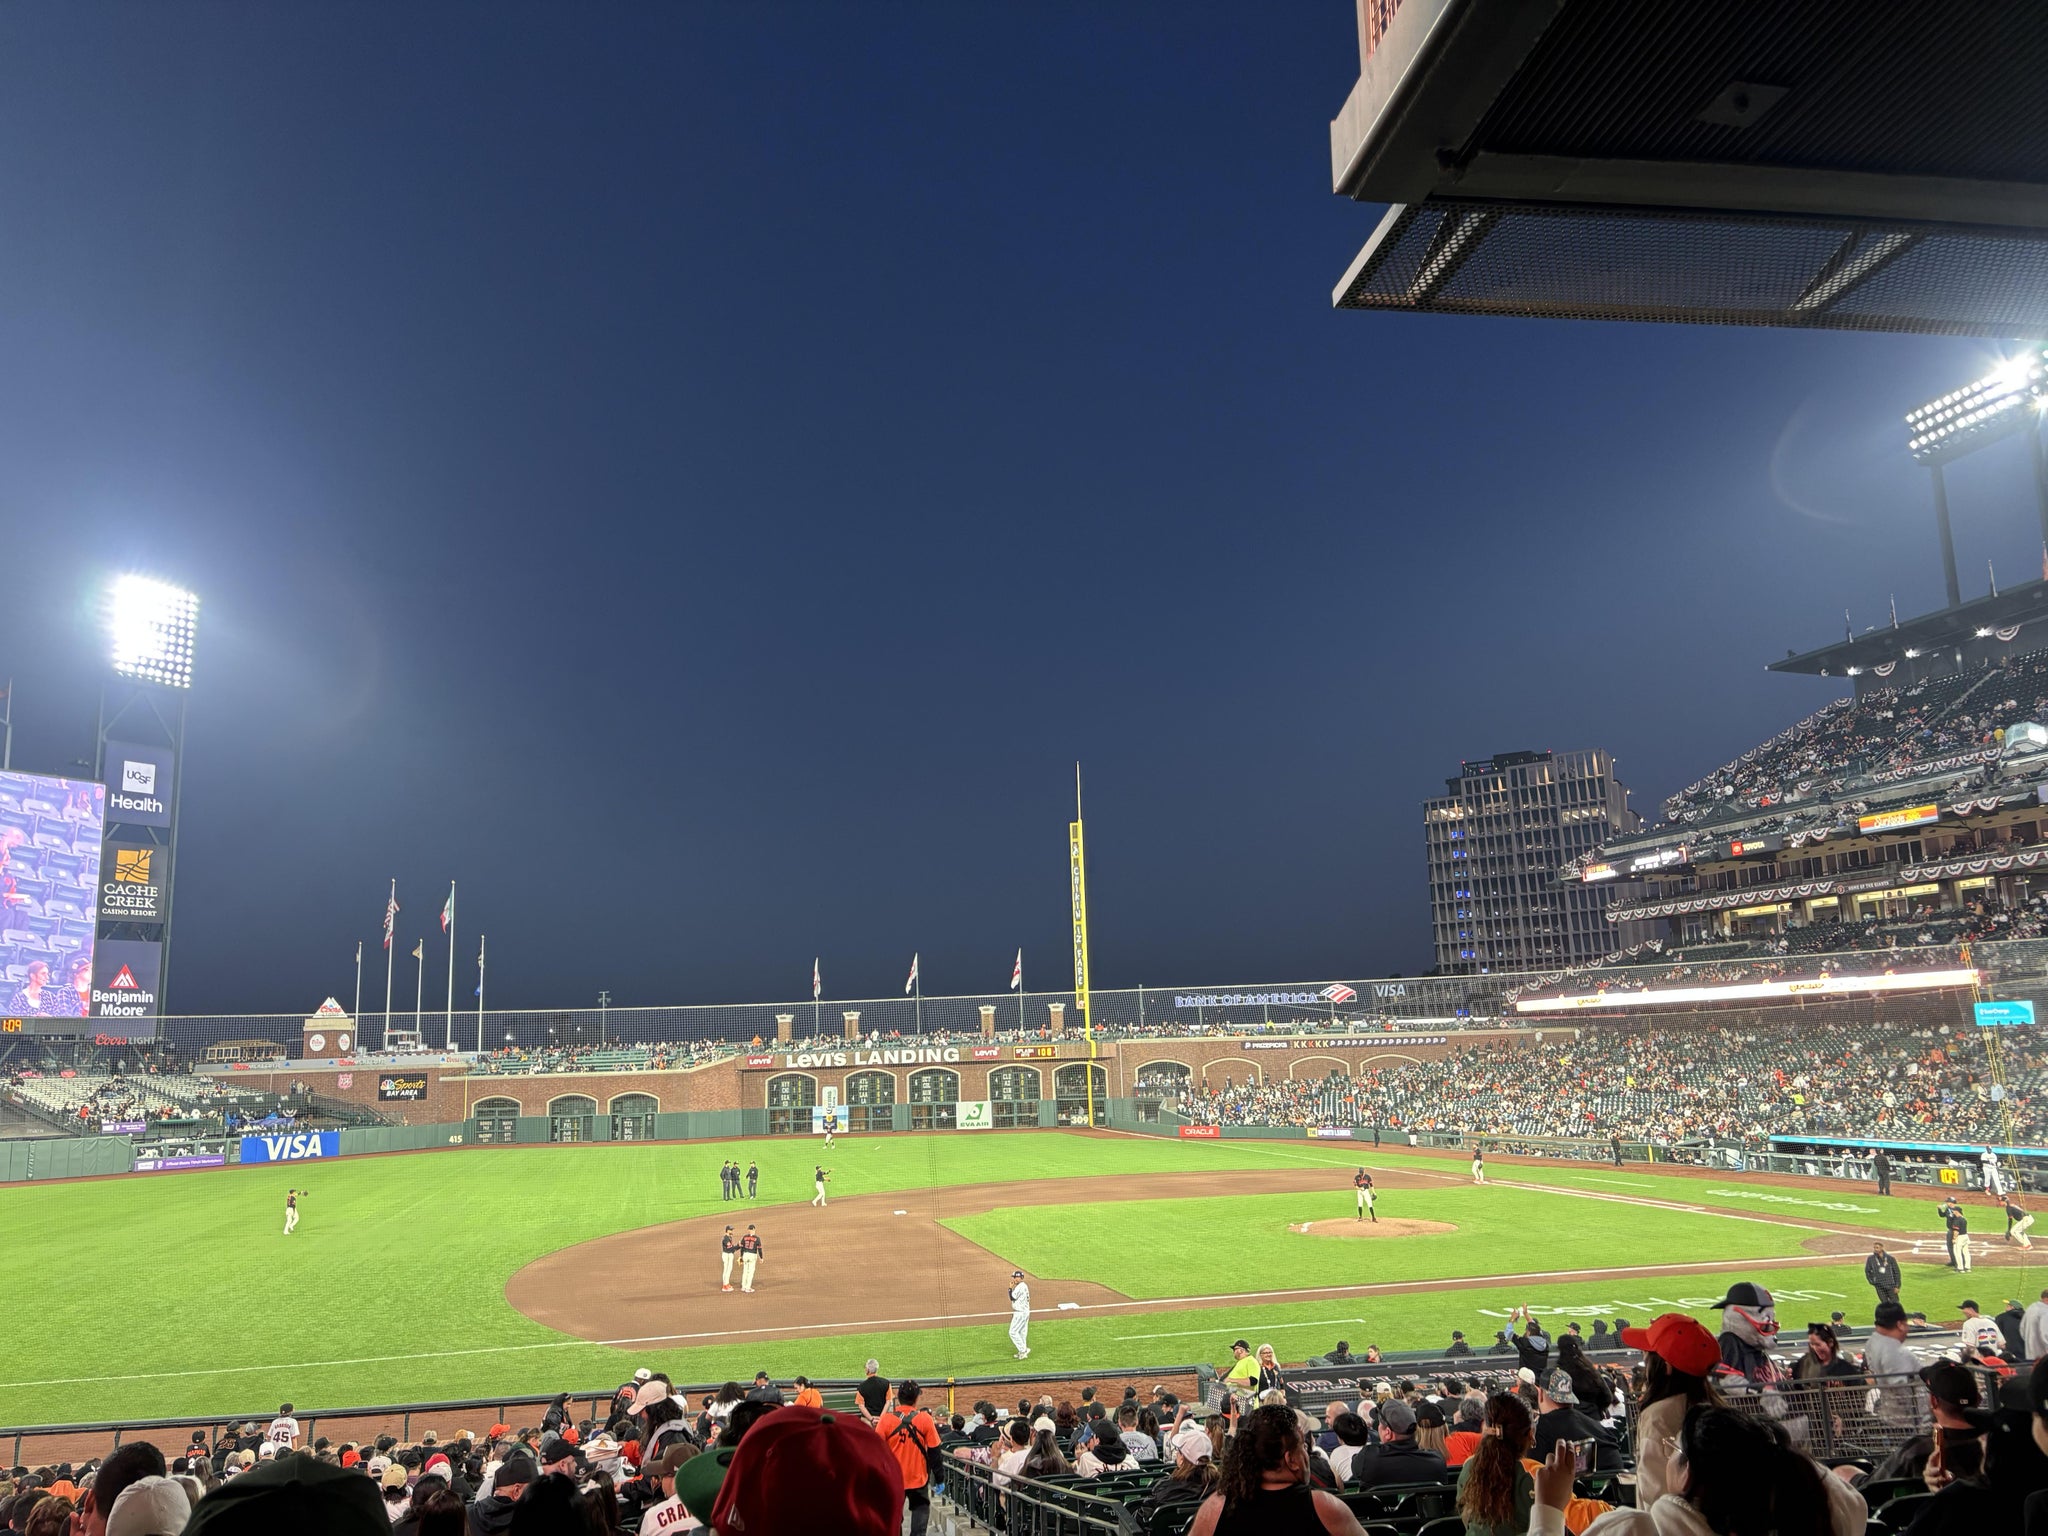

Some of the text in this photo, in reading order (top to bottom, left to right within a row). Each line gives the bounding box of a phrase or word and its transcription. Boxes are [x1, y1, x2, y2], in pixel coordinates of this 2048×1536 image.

[127, 770, 151, 784] UCSF
[111, 793, 162, 813] Health
[1742, 840, 1765, 851] TOYOTA
[103, 883, 158, 897] CACHE
[104, 895, 156, 909] CREEK
[101, 908, 157, 917] CASINO RESORT
[1375, 983, 1406, 997] VISA
[92, 990, 153, 1005] Benjamin
[1174, 992, 1318, 1008] BANK OF AMERICA
[100, 1004, 144, 1016] Moore
[95, 1033, 155, 1045] Coors LIGHT
[854, 1048, 961, 1066] LANDING
[394, 1079, 426, 1091] Sports
[1071, 1116, 1089, 1124] 309
[449, 1135, 463, 1144] 415
[261, 1134, 322, 1160] VISA
[273, 1431, 290, 1442] 45
[656, 1502, 693, 1528] CRA
